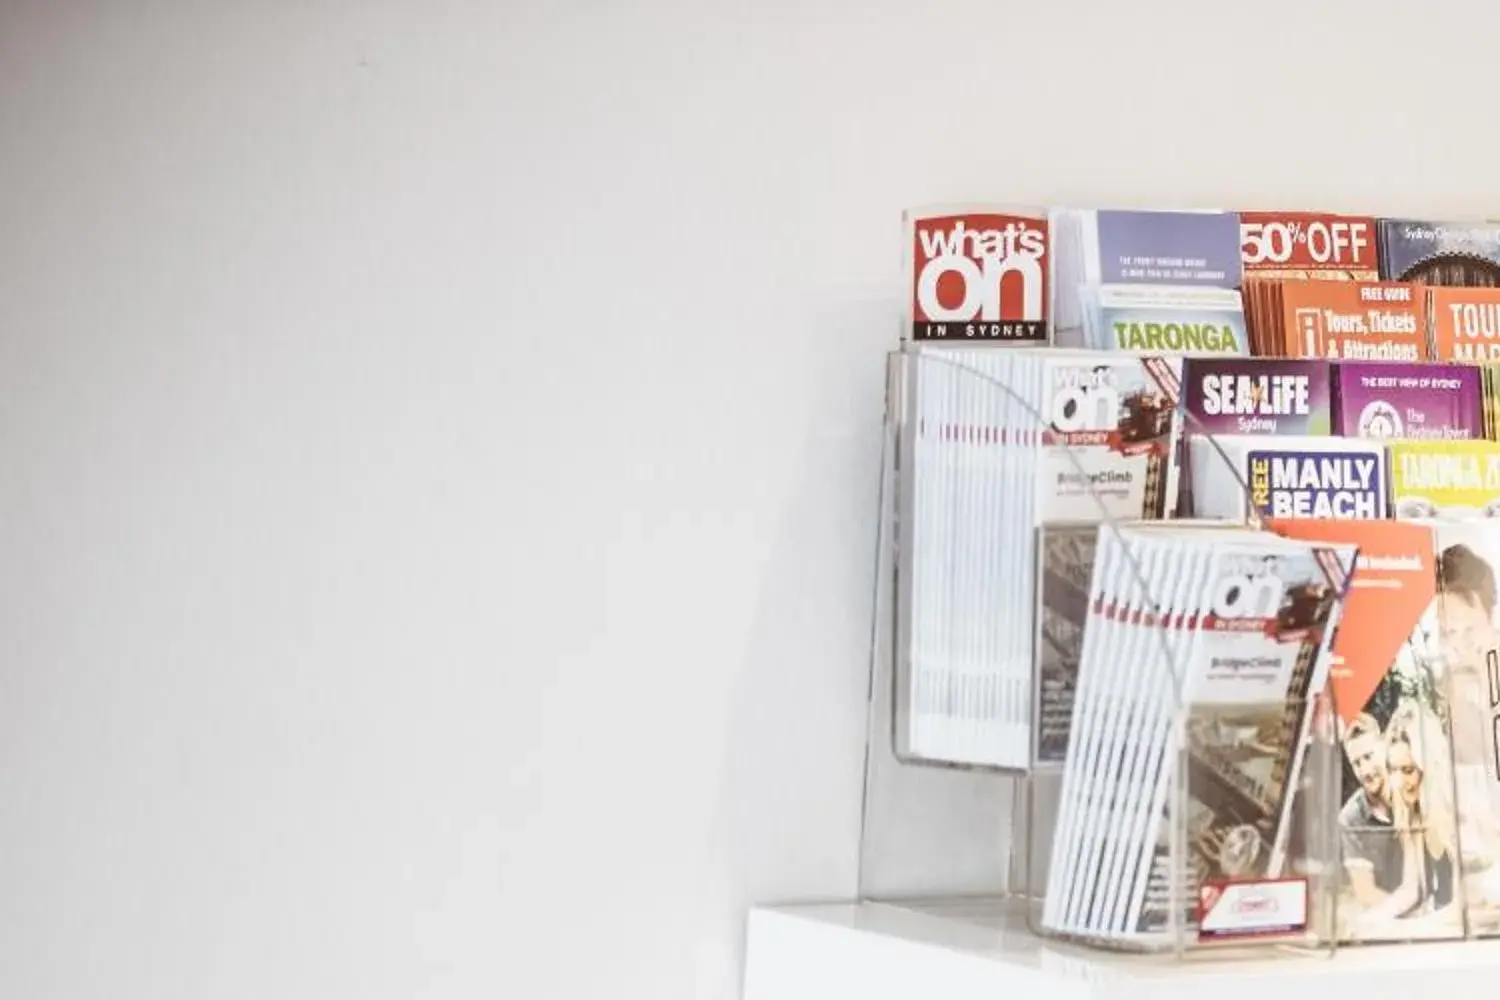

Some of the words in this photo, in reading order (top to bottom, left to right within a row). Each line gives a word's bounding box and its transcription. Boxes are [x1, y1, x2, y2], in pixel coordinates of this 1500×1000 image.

[919, 220, 1046, 262] what's
[1241, 222, 1306, 263] 50%
[1308, 223, 1367, 263] OFF
[919, 256, 1042, 322] on
[1361, 288, 1383, 300] FREE
[927, 324, 947, 337] IN
[966, 324, 1037, 337] SYDNEY
[1113, 322, 1239, 352] TARONGA
[1324, 310, 1368, 335] Tours,
[1368, 310, 1416, 334] Tickets
[1202, 374, 1256, 414] SEA
[1237, 417, 1277, 434] Sydney
[1249, 457, 1270, 507] REE
[1272, 458, 1374, 490] MANLY
[1272, 493, 1375, 518] BEACH
